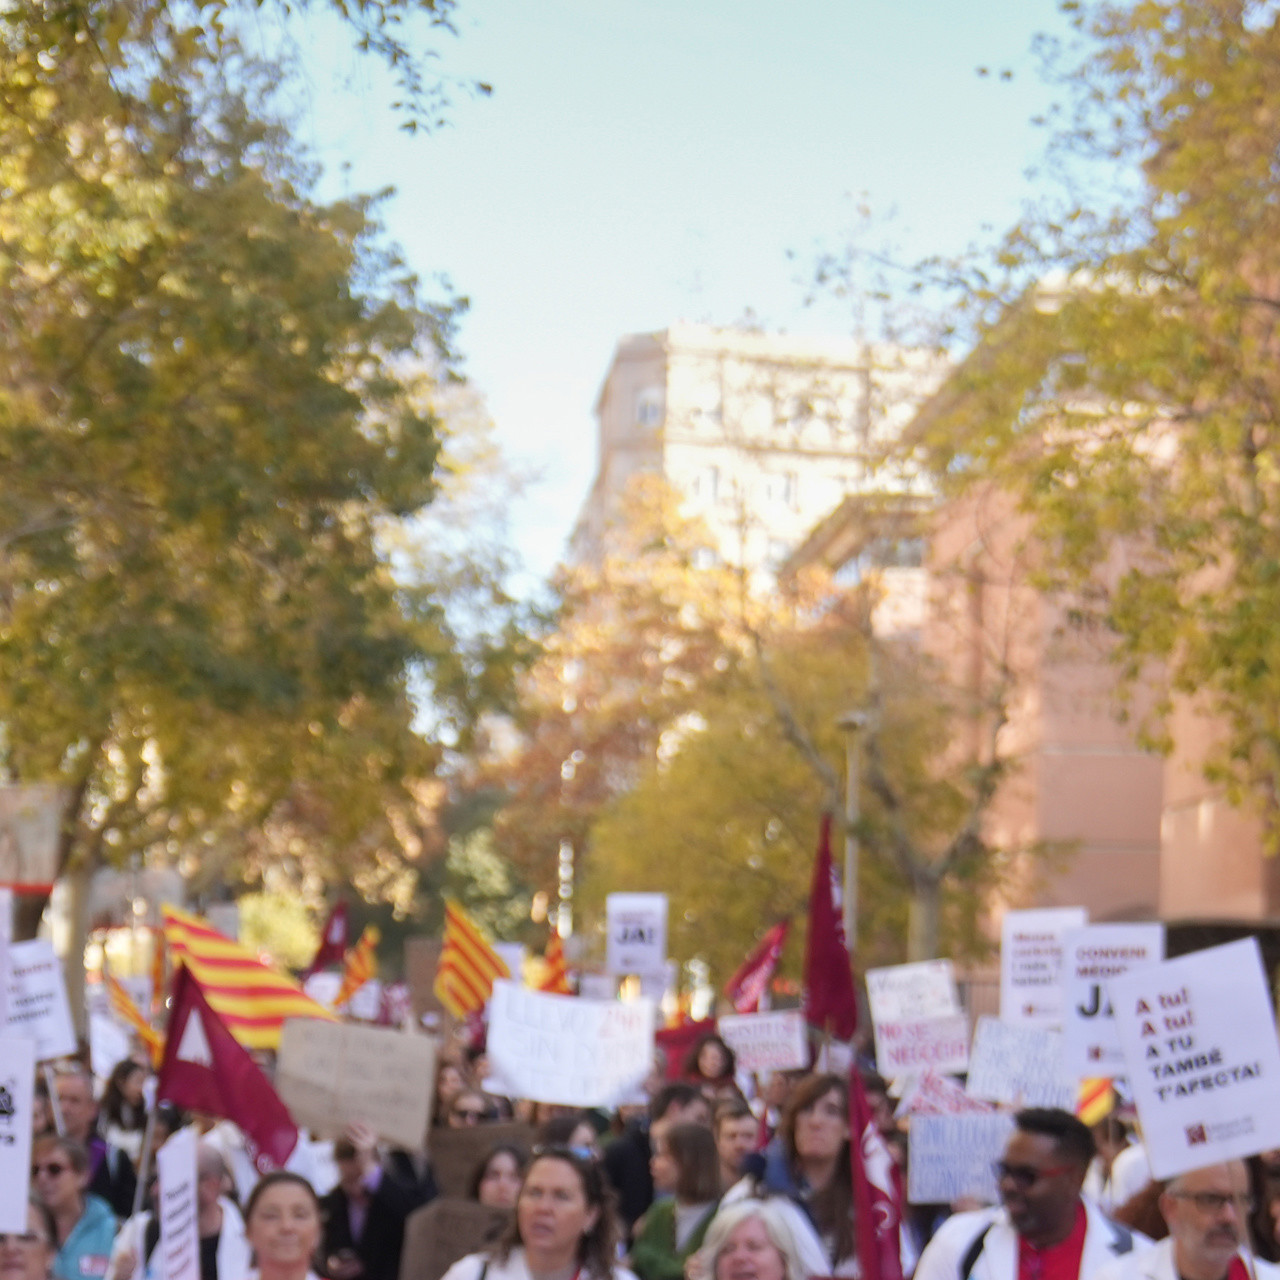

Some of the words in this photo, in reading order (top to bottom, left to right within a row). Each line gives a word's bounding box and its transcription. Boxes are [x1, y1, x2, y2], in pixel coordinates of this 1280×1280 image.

[1076, 946, 1147, 961] CONVENI
[1136, 998, 1152, 1014] A
[1159, 987, 1190, 1010] tu!
[1141, 1022, 1157, 1037] A
[1163, 1009, 1195, 1031] tu!
[1146, 1045, 1160, 1059] A
[1166, 1034, 1194, 1053] TU
[1151, 1047, 1223, 1080] TAMBÉ
[1155, 1062, 1262, 1103] T'AFECTA!
